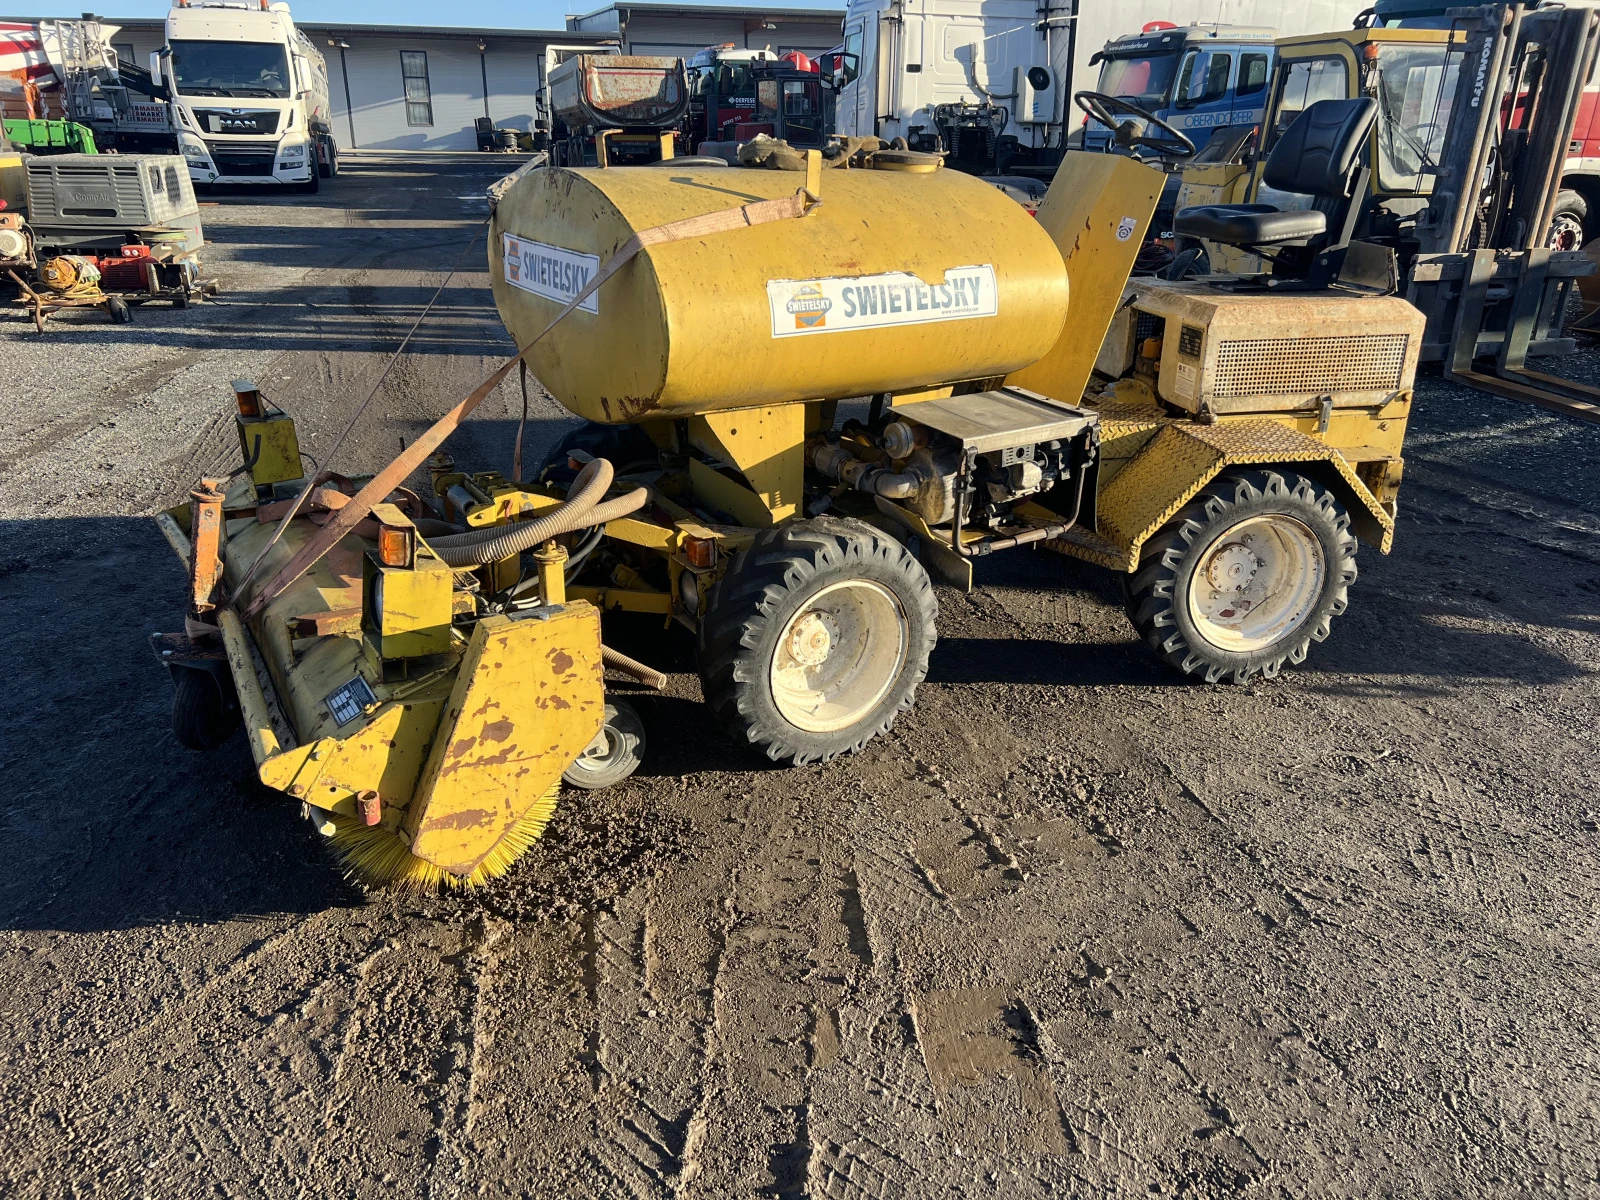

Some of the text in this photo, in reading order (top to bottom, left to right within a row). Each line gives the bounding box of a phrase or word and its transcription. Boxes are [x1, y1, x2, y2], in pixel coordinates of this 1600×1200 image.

[1471, 37, 1493, 107] KOMATSU
[220, 120, 257, 128] MAN
[1184, 111, 1254, 128] OBERNDORFER
[523, 251, 590, 295] SWIETELSKY
[788, 299, 830, 313] SWIETELSKY
[841, 276, 981, 318] SWIETELSKY
